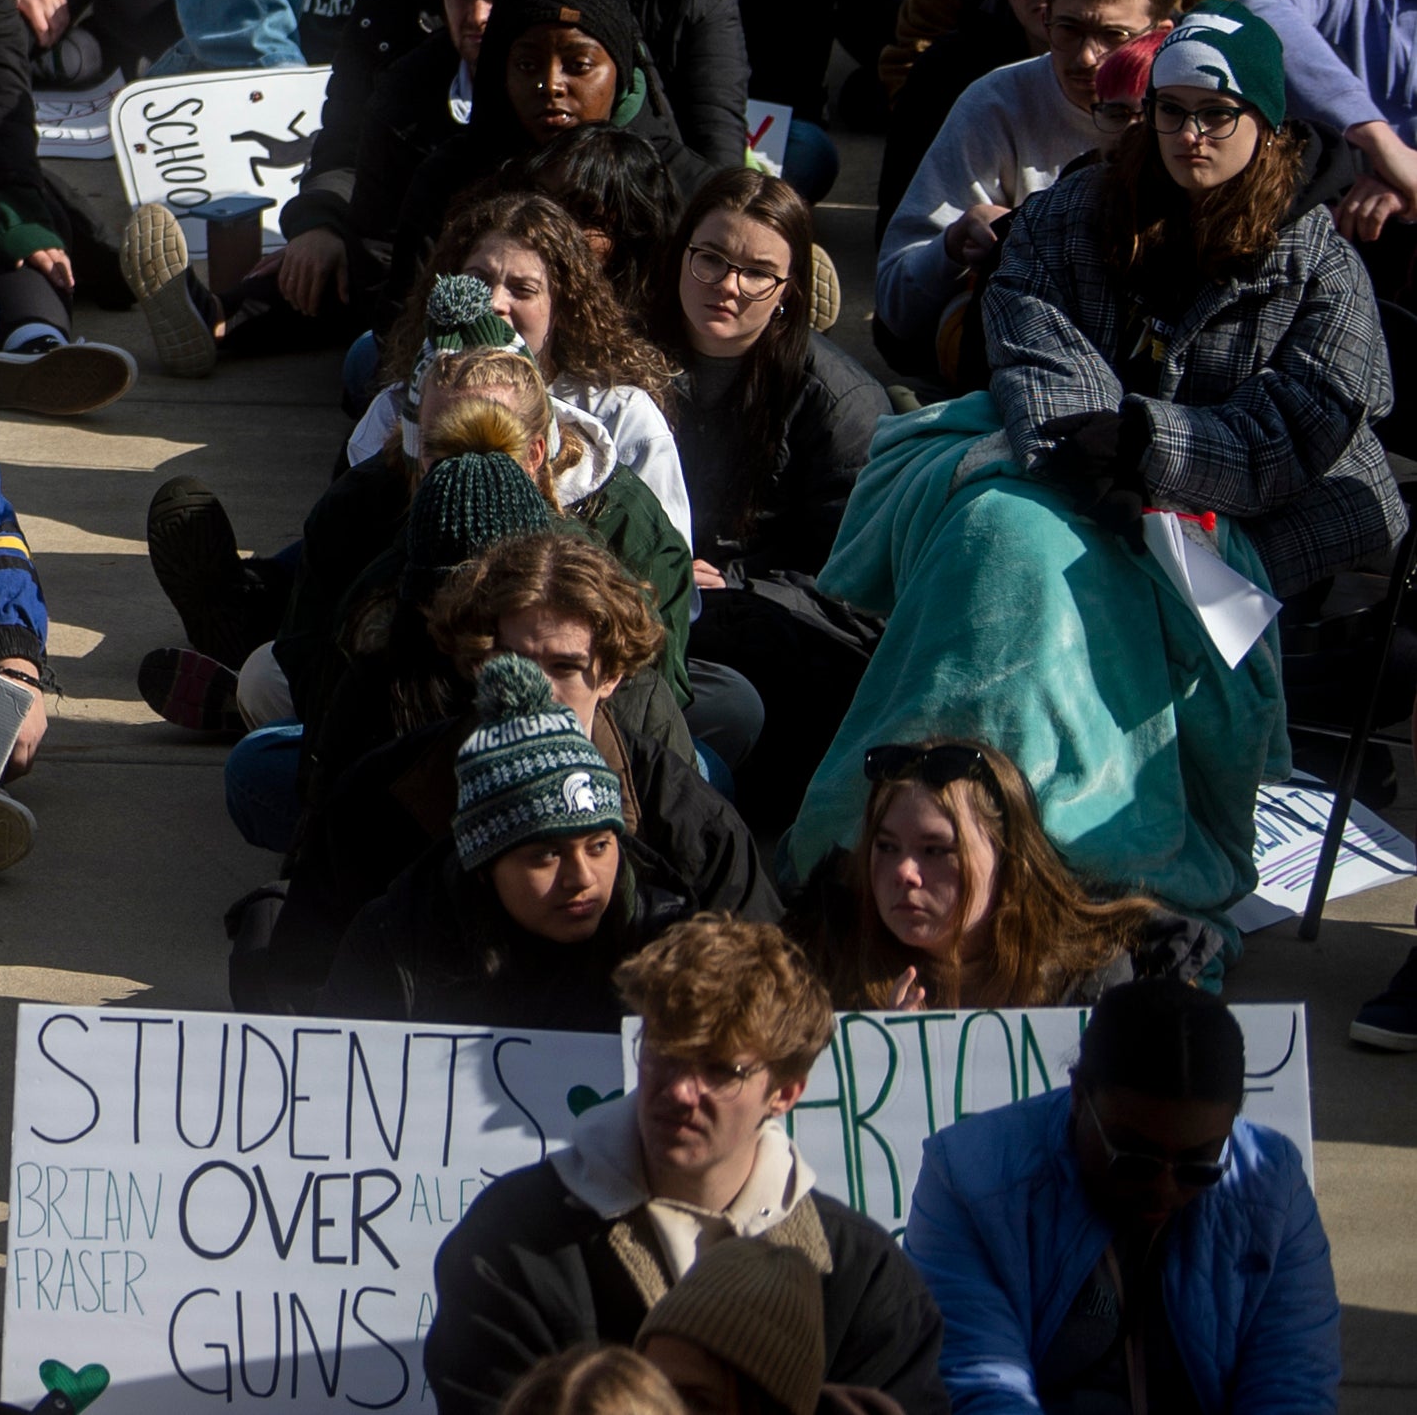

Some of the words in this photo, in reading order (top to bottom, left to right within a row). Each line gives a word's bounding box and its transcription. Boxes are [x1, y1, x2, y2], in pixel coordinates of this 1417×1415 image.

[143, 97, 213, 208] SCHOO
[458, 711, 570, 757] MICHIGAN
[30, 1013, 547, 1178] STUDENTS
[16, 1161, 163, 1241] BRIAN
[178, 1159, 403, 1270] OVER
[409, 1173, 501, 1226] ALE
[13, 1246, 148, 1316] FRASER
[168, 1286, 410, 1410] GUNS
